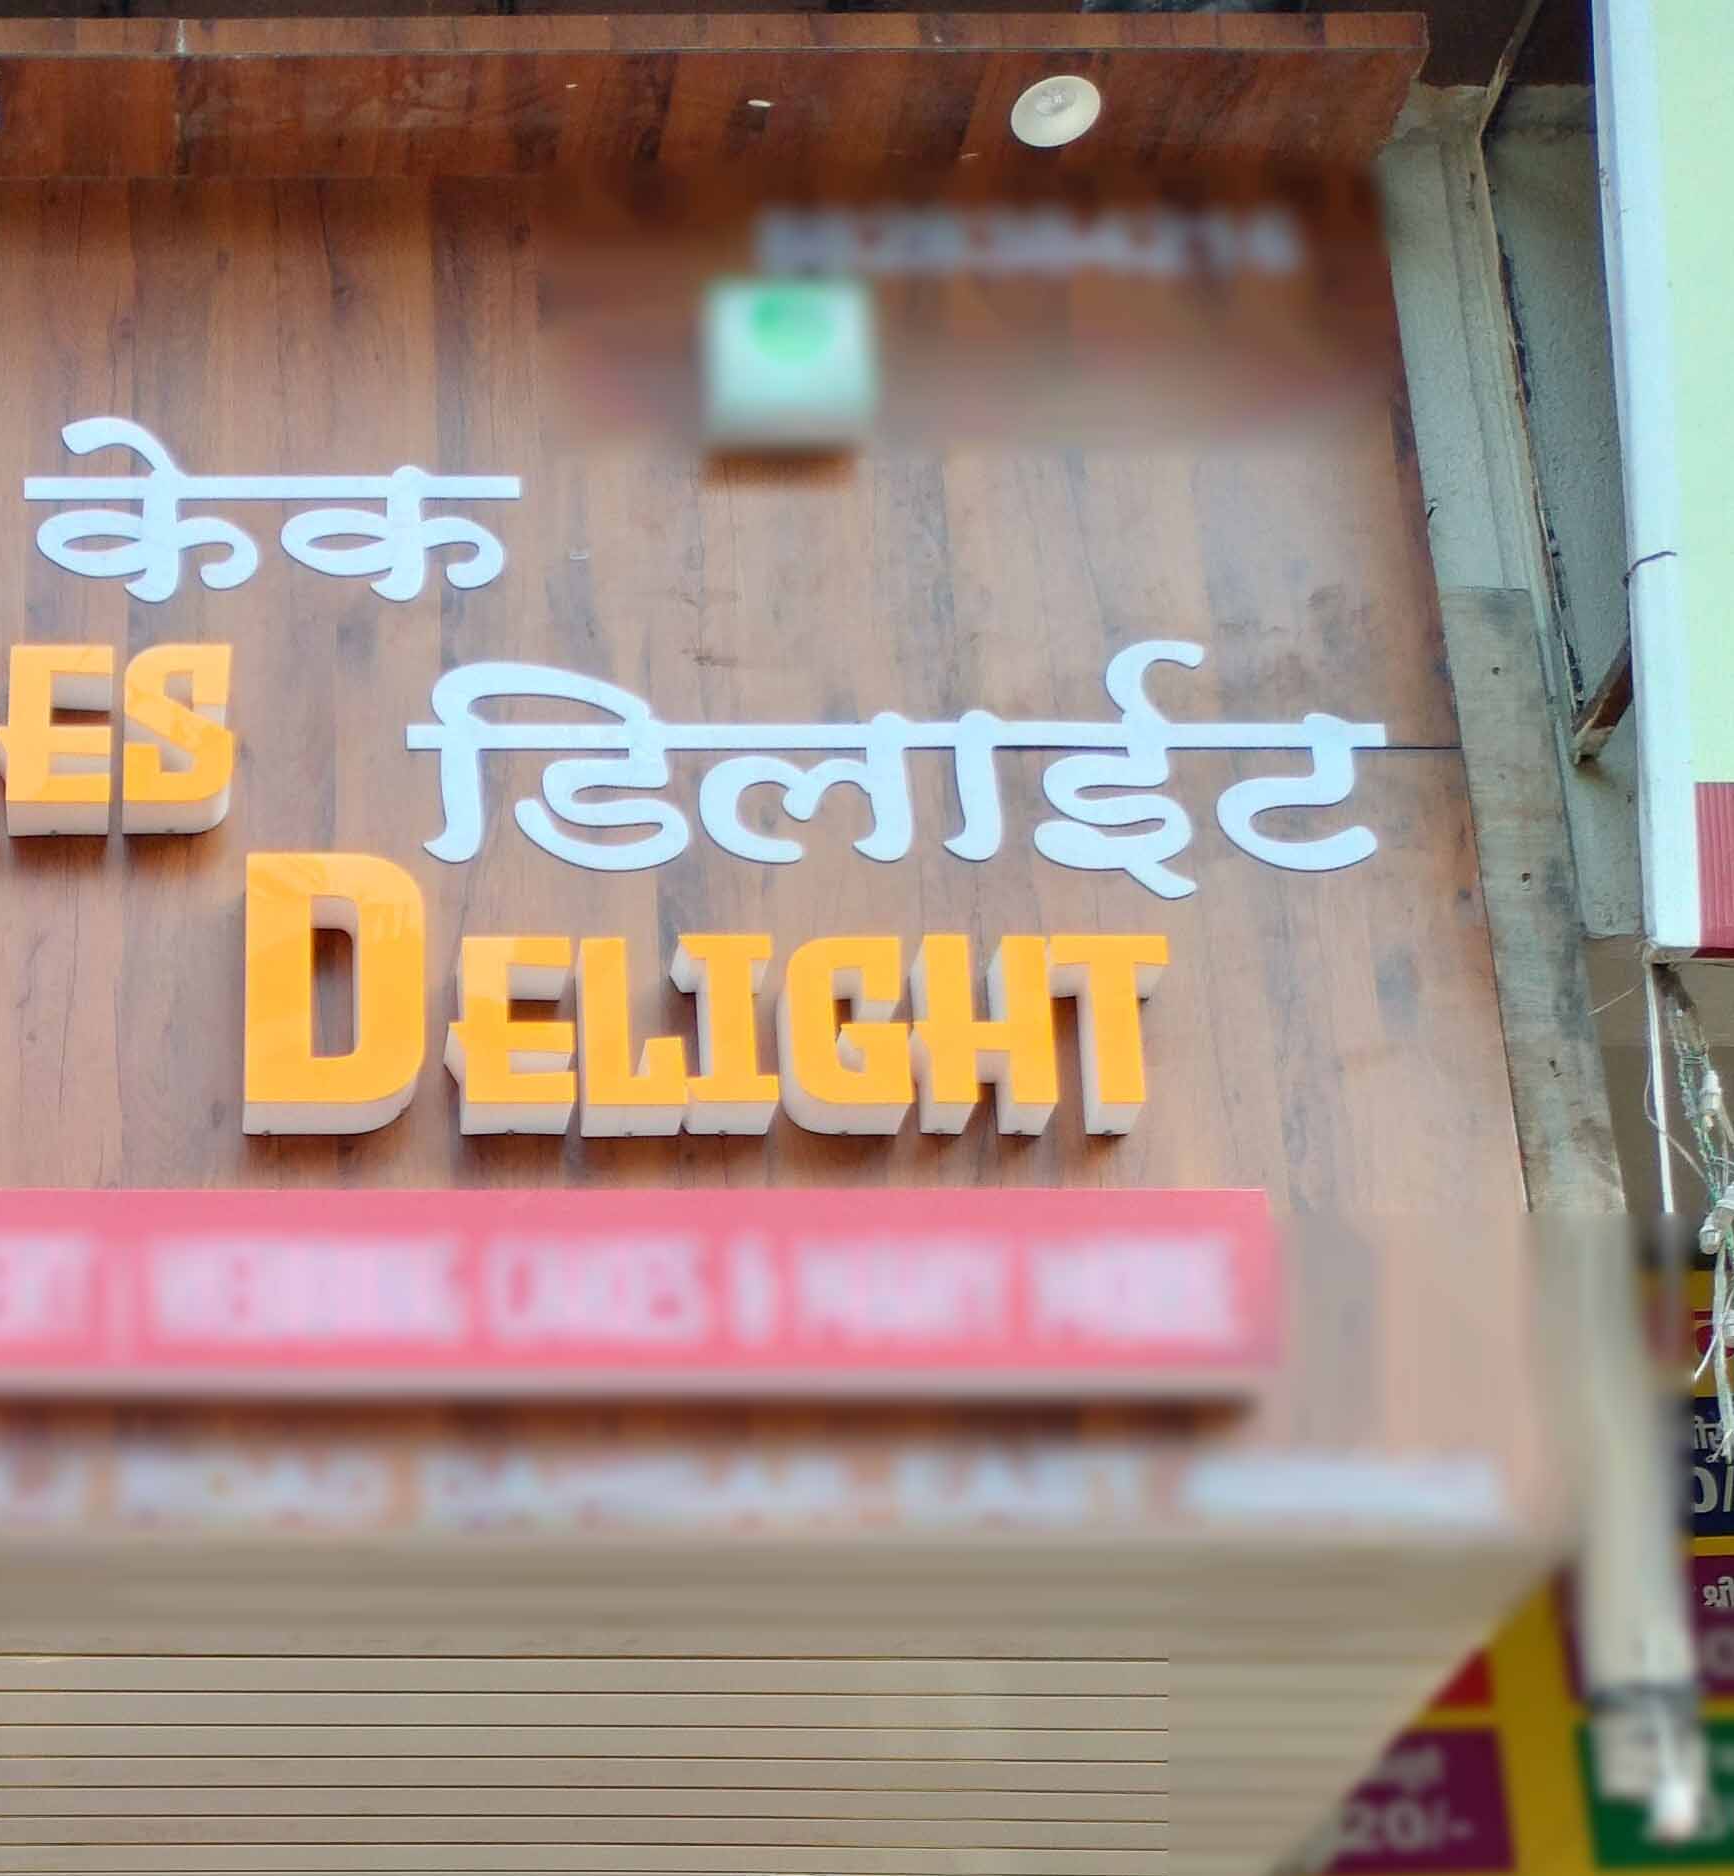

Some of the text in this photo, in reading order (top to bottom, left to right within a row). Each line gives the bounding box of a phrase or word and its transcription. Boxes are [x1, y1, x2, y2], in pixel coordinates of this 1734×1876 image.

[23, 416, 521, 602] केक
[405, 639, 1387, 901] डिलाईट
[242, 852, 1170, 1138] DELIGHT
